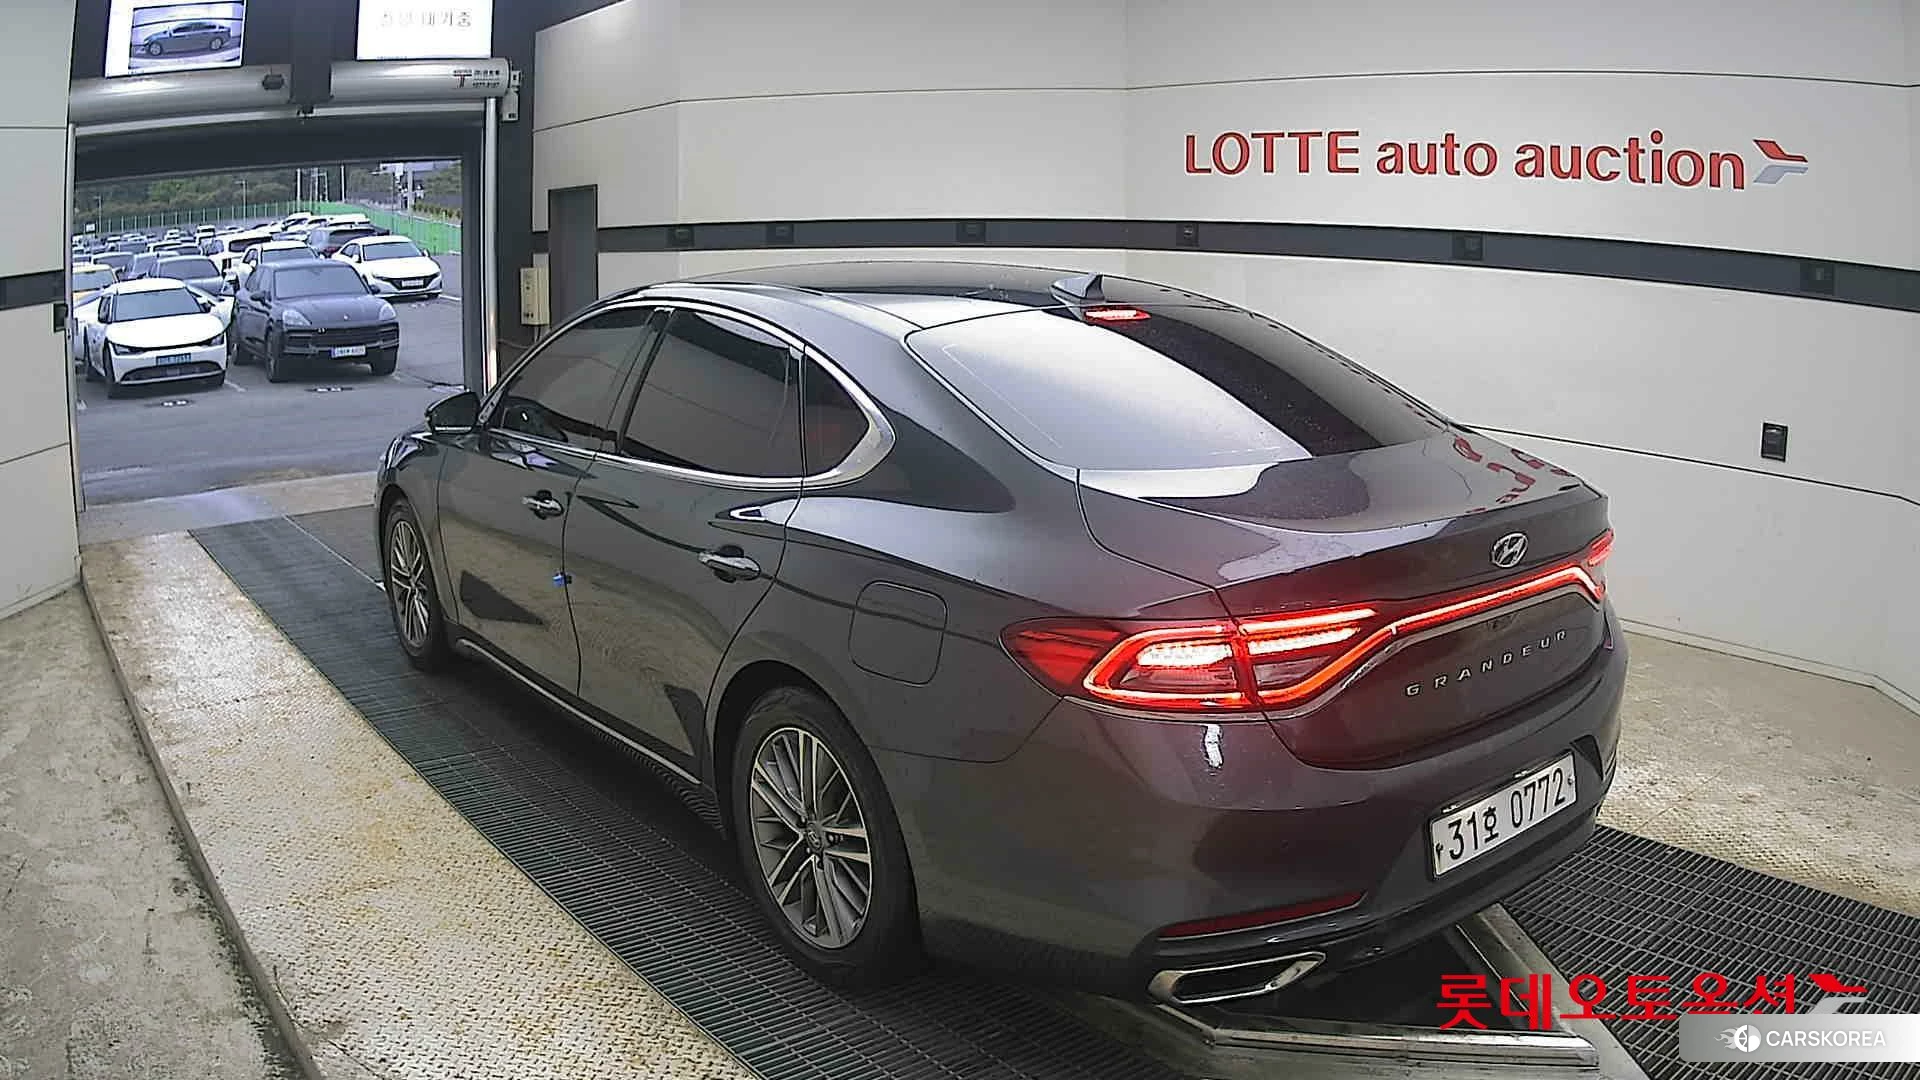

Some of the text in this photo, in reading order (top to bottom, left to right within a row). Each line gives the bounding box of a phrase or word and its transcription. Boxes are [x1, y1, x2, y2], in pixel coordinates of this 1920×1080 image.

[1185, 129, 1745, 191] LOTTE auto auction
[1406, 630, 1567, 697] GRANDEUR
[1448, 766, 1567, 861] 31호 0772
